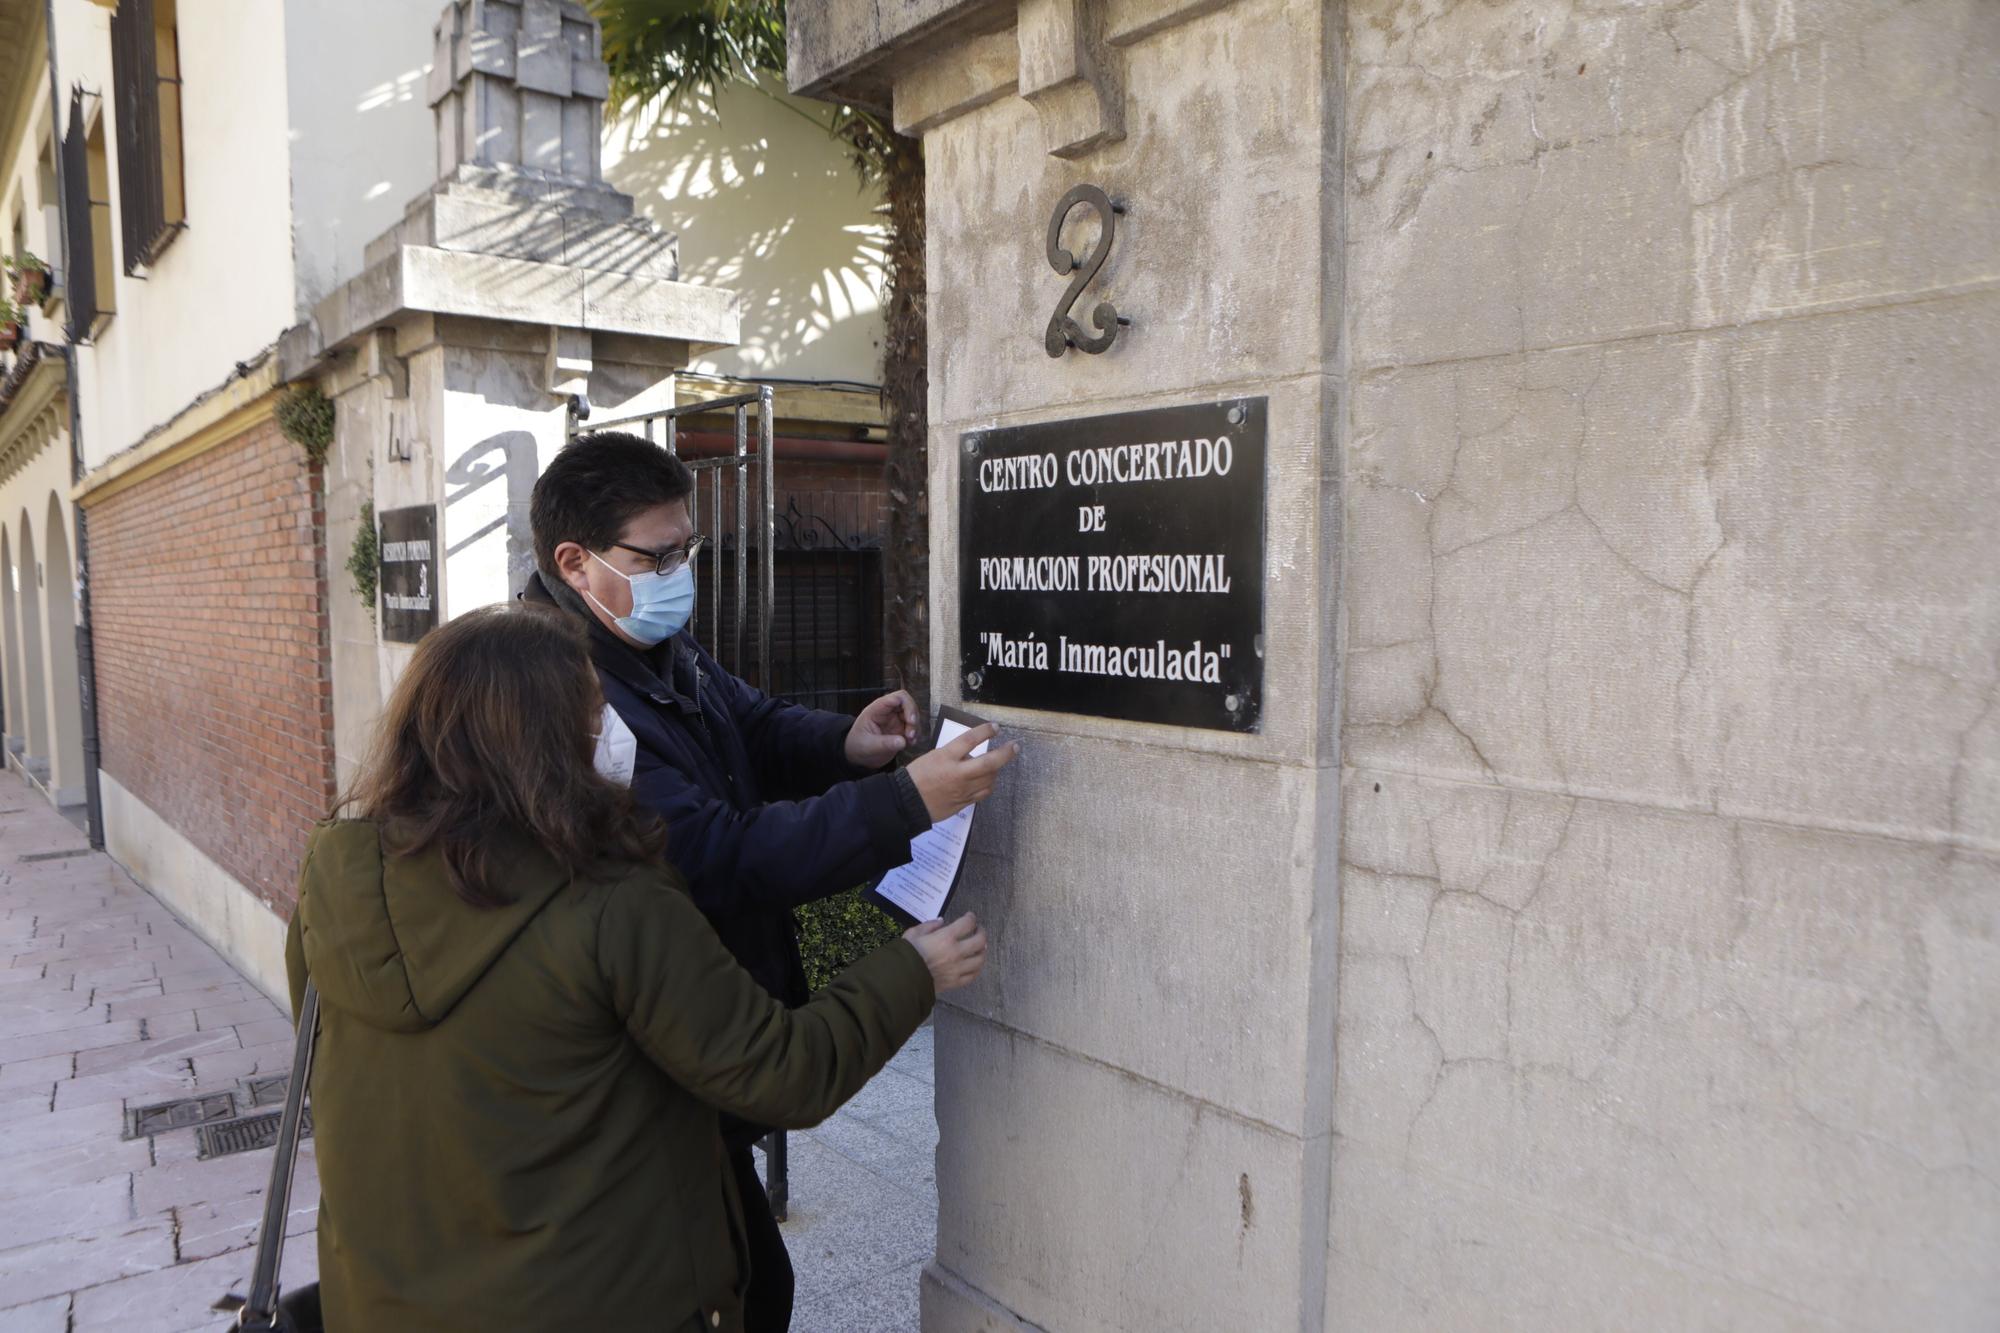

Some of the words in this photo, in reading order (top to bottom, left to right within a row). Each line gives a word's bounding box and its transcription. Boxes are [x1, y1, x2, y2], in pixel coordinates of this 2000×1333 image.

[1045, 183, 1118, 359] 2
[980, 453, 1058, 492] CENTRO
[1067, 436, 1233, 486] CONCERTADO
[1079, 506, 1106, 532] DE
[980, 556, 1079, 591] FORMACION
[1088, 554, 1231, 593] PROFESIONAL
[981, 632, 1048, 670] "María
[1059, 636, 1230, 683] Inmaculada"
